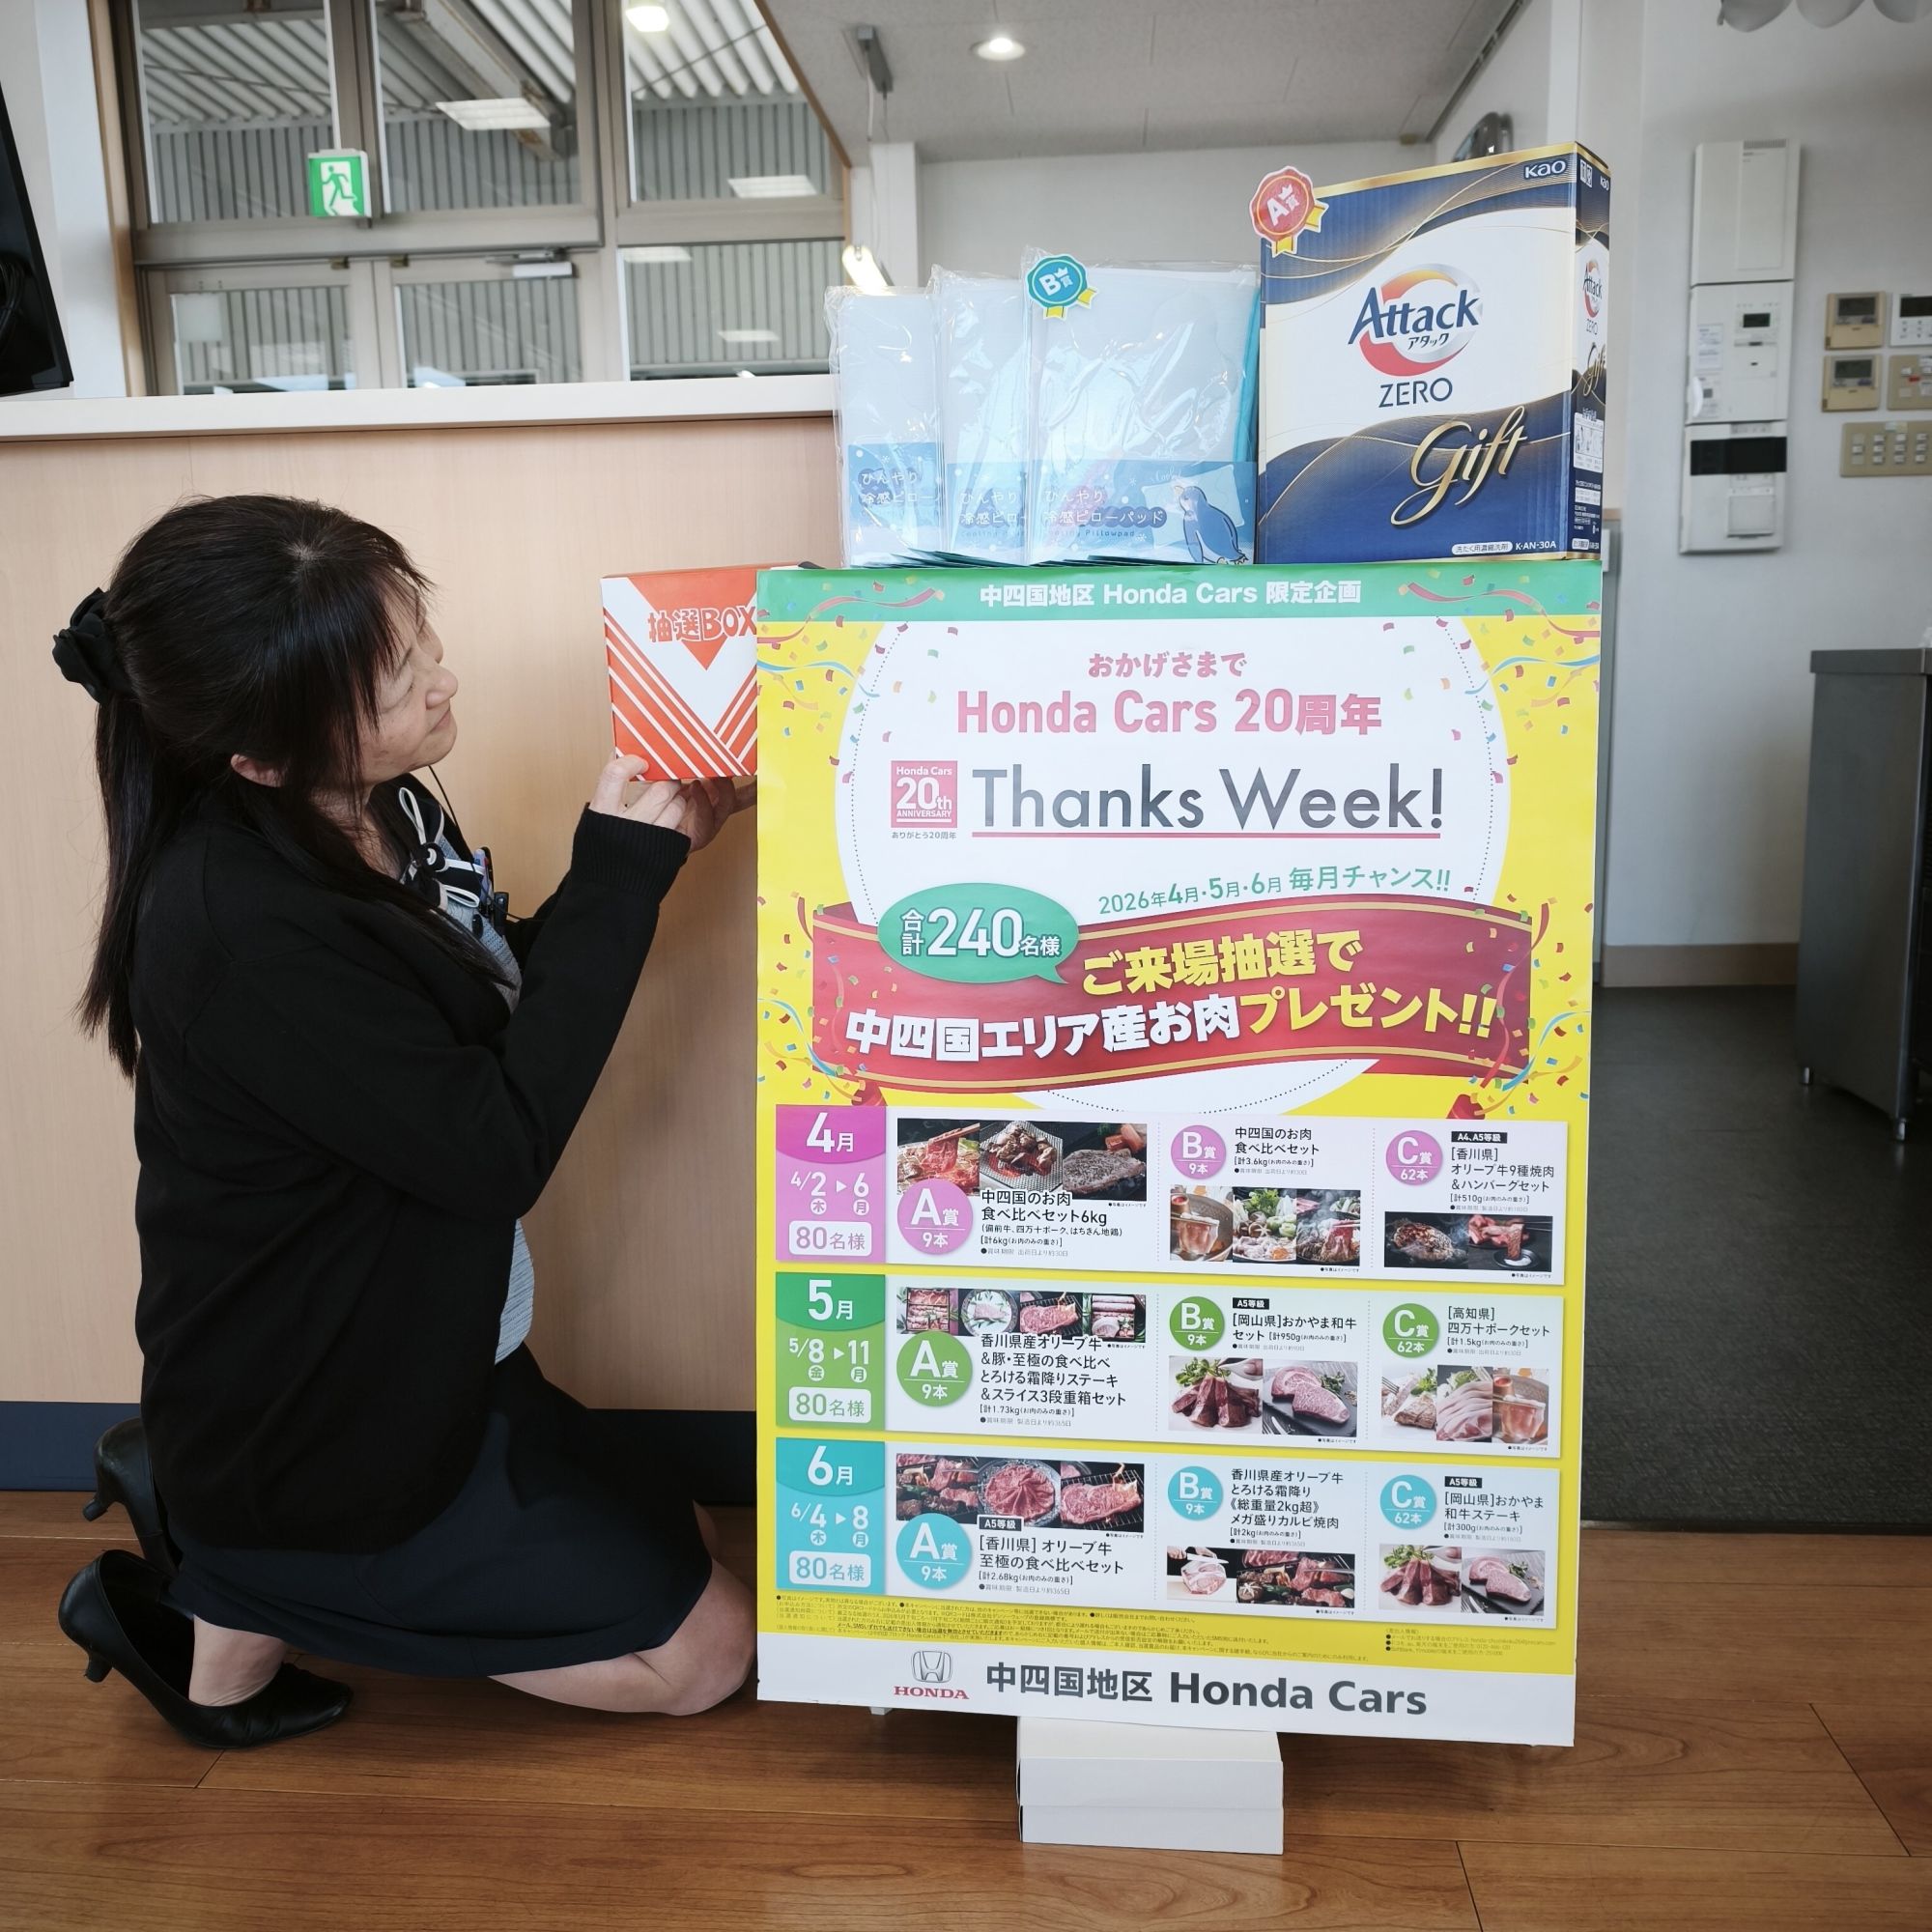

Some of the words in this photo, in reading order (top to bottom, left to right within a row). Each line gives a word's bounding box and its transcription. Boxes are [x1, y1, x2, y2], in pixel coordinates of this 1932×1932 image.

[1348, 287, 1480, 346] Attack
[1407, 333, 1449, 350] アタック
[1378, 377, 1454, 408] ZERO
[1390, 406, 1528, 526] Gift
[861, 470, 918, 485] ひんやり
[861, 491, 941, 505] 冷感ピロー
[1043, 510, 1163, 525] 冷感ピローパッド
[980, 583, 1094, 609] 中四国地区
[1103, 582, 1187, 605] Honda
[1196, 582, 1258, 605] Cars
[1265, 580, 1361, 605] 限定企画
[647, 606, 756, 643] 抽選BOX
[1088, 650, 1248, 678] おかげさまで
[957, 690, 1097, 733] Honda
[1114, 689, 1217, 733] Cars
[1235, 688, 1382, 736] 20周年
[896, 765, 929, 776] Honda
[931, 766, 952, 776] Cars
[895, 776, 952, 810] 20th
[972, 763, 1205, 829] Thanks
[1218, 762, 1442, 831] Week!
[896, 810, 952, 818] ANNIVERSARY
[892, 831, 957, 839] ありがとう20周年
[1289, 866, 1451, 892] 毎月チャンス!!
[1082, 929, 1363, 996] ご来場抽選で
[806, 1112, 854, 1153] 4月
[1235, 1126, 1312, 1141] 中四国のお肉
[1182, 1131, 1216, 1159] B賞
[1235, 1141, 1320, 1155] 食べ比べセット
[1397, 1136, 1433, 1165] C賞
[1451, 1147, 1498, 1161] [香川県]
[1188, 1163, 1208, 1175] 9本
[1400, 1168, 1429, 1180] 62本
[1451, 1163, 1554, 1178] オリーブ牛9種焼肉
[790, 1171, 827, 1197] 4/2
[853, 1172, 869, 1198] 6
[1451, 1179, 1549, 1193] &ハンバーグセット
[811, 1200, 826, 1213] 木
[855, 1201, 868, 1214] 月
[911, 1187, 960, 1227] A賞
[981, 1190, 1071, 1206] 中四国のお肉
[981, 1207, 1107, 1226] 食べ比べセット6kg
[796, 1226, 866, 1250] 80名様
[922, 1231, 950, 1248] 9本
[808, 1279, 853, 1321] 5月
[1180, 1302, 1214, 1330] B賞
[1233, 1313, 1357, 1329] [岡山県]おかやま和牛
[1448, 1306, 1495, 1321] [高知県]
[1394, 1309, 1429, 1338] C賞
[1448, 1322, 1550, 1337] 四万十ポークセット
[980, 1333, 1102, 1351] 香川県産オリーブ牛
[1187, 1334, 1207, 1346] 9本
[1233, 1330, 1265, 1342] セット
[789, 1337, 825, 1363] 5/8
[848, 1339, 869, 1365] 11
[1397, 1341, 1425, 1353] 62本
[911, 1340, 959, 1378] A賞
[980, 1351, 1111, 1369] &豚・至極の食べ比べ
[852, 1368, 866, 1381] 月
[980, 1370, 1119, 1388] とろける霜降りステーキ
[922, 1383, 949, 1401] 9本
[980, 1388, 1126, 1406] &スライス3段重箱セット
[796, 1393, 865, 1417] 80名様
[808, 1445, 853, 1486] 6月
[1179, 1471, 1212, 1500] B賞
[1232, 1468, 1344, 1485] 香川県産オリーブ牛
[1232, 1484, 1311, 1497] とろける霜降り
[1391, 1481, 1425, 1509] C賞
[1444, 1492, 1544, 1508] [岡山県]おかやま
[791, 1502, 827, 1528] 6/4
[852, 1505, 868, 1530] 8
[1185, 1503, 1205, 1516] 9本
[1394, 1512, 1422, 1524] 62本
[1444, 1508, 1520, 1521] 和牛ステーキ
[1231, 1514, 1339, 1529] メガ盛りカルビ焼肉
[811, 1531, 826, 1545] 木
[854, 1533, 867, 1547] 月
[910, 1521, 957, 1561] A賞
[979, 1535, 1037, 1553] [香川県]
[1041, 1540, 1112, 1556] オリーブ牛
[796, 1556, 865, 1581] 80名様
[979, 1553, 1123, 1574] 至極の食べ比べセット
[921, 1565, 948, 1581] 9本
[894, 1686, 970, 1700] HONDA
[986, 1662, 1152, 1702] 中四国地区
[1170, 1671, 1314, 1710] Honda
[1328, 1679, 1428, 1716] Cars
